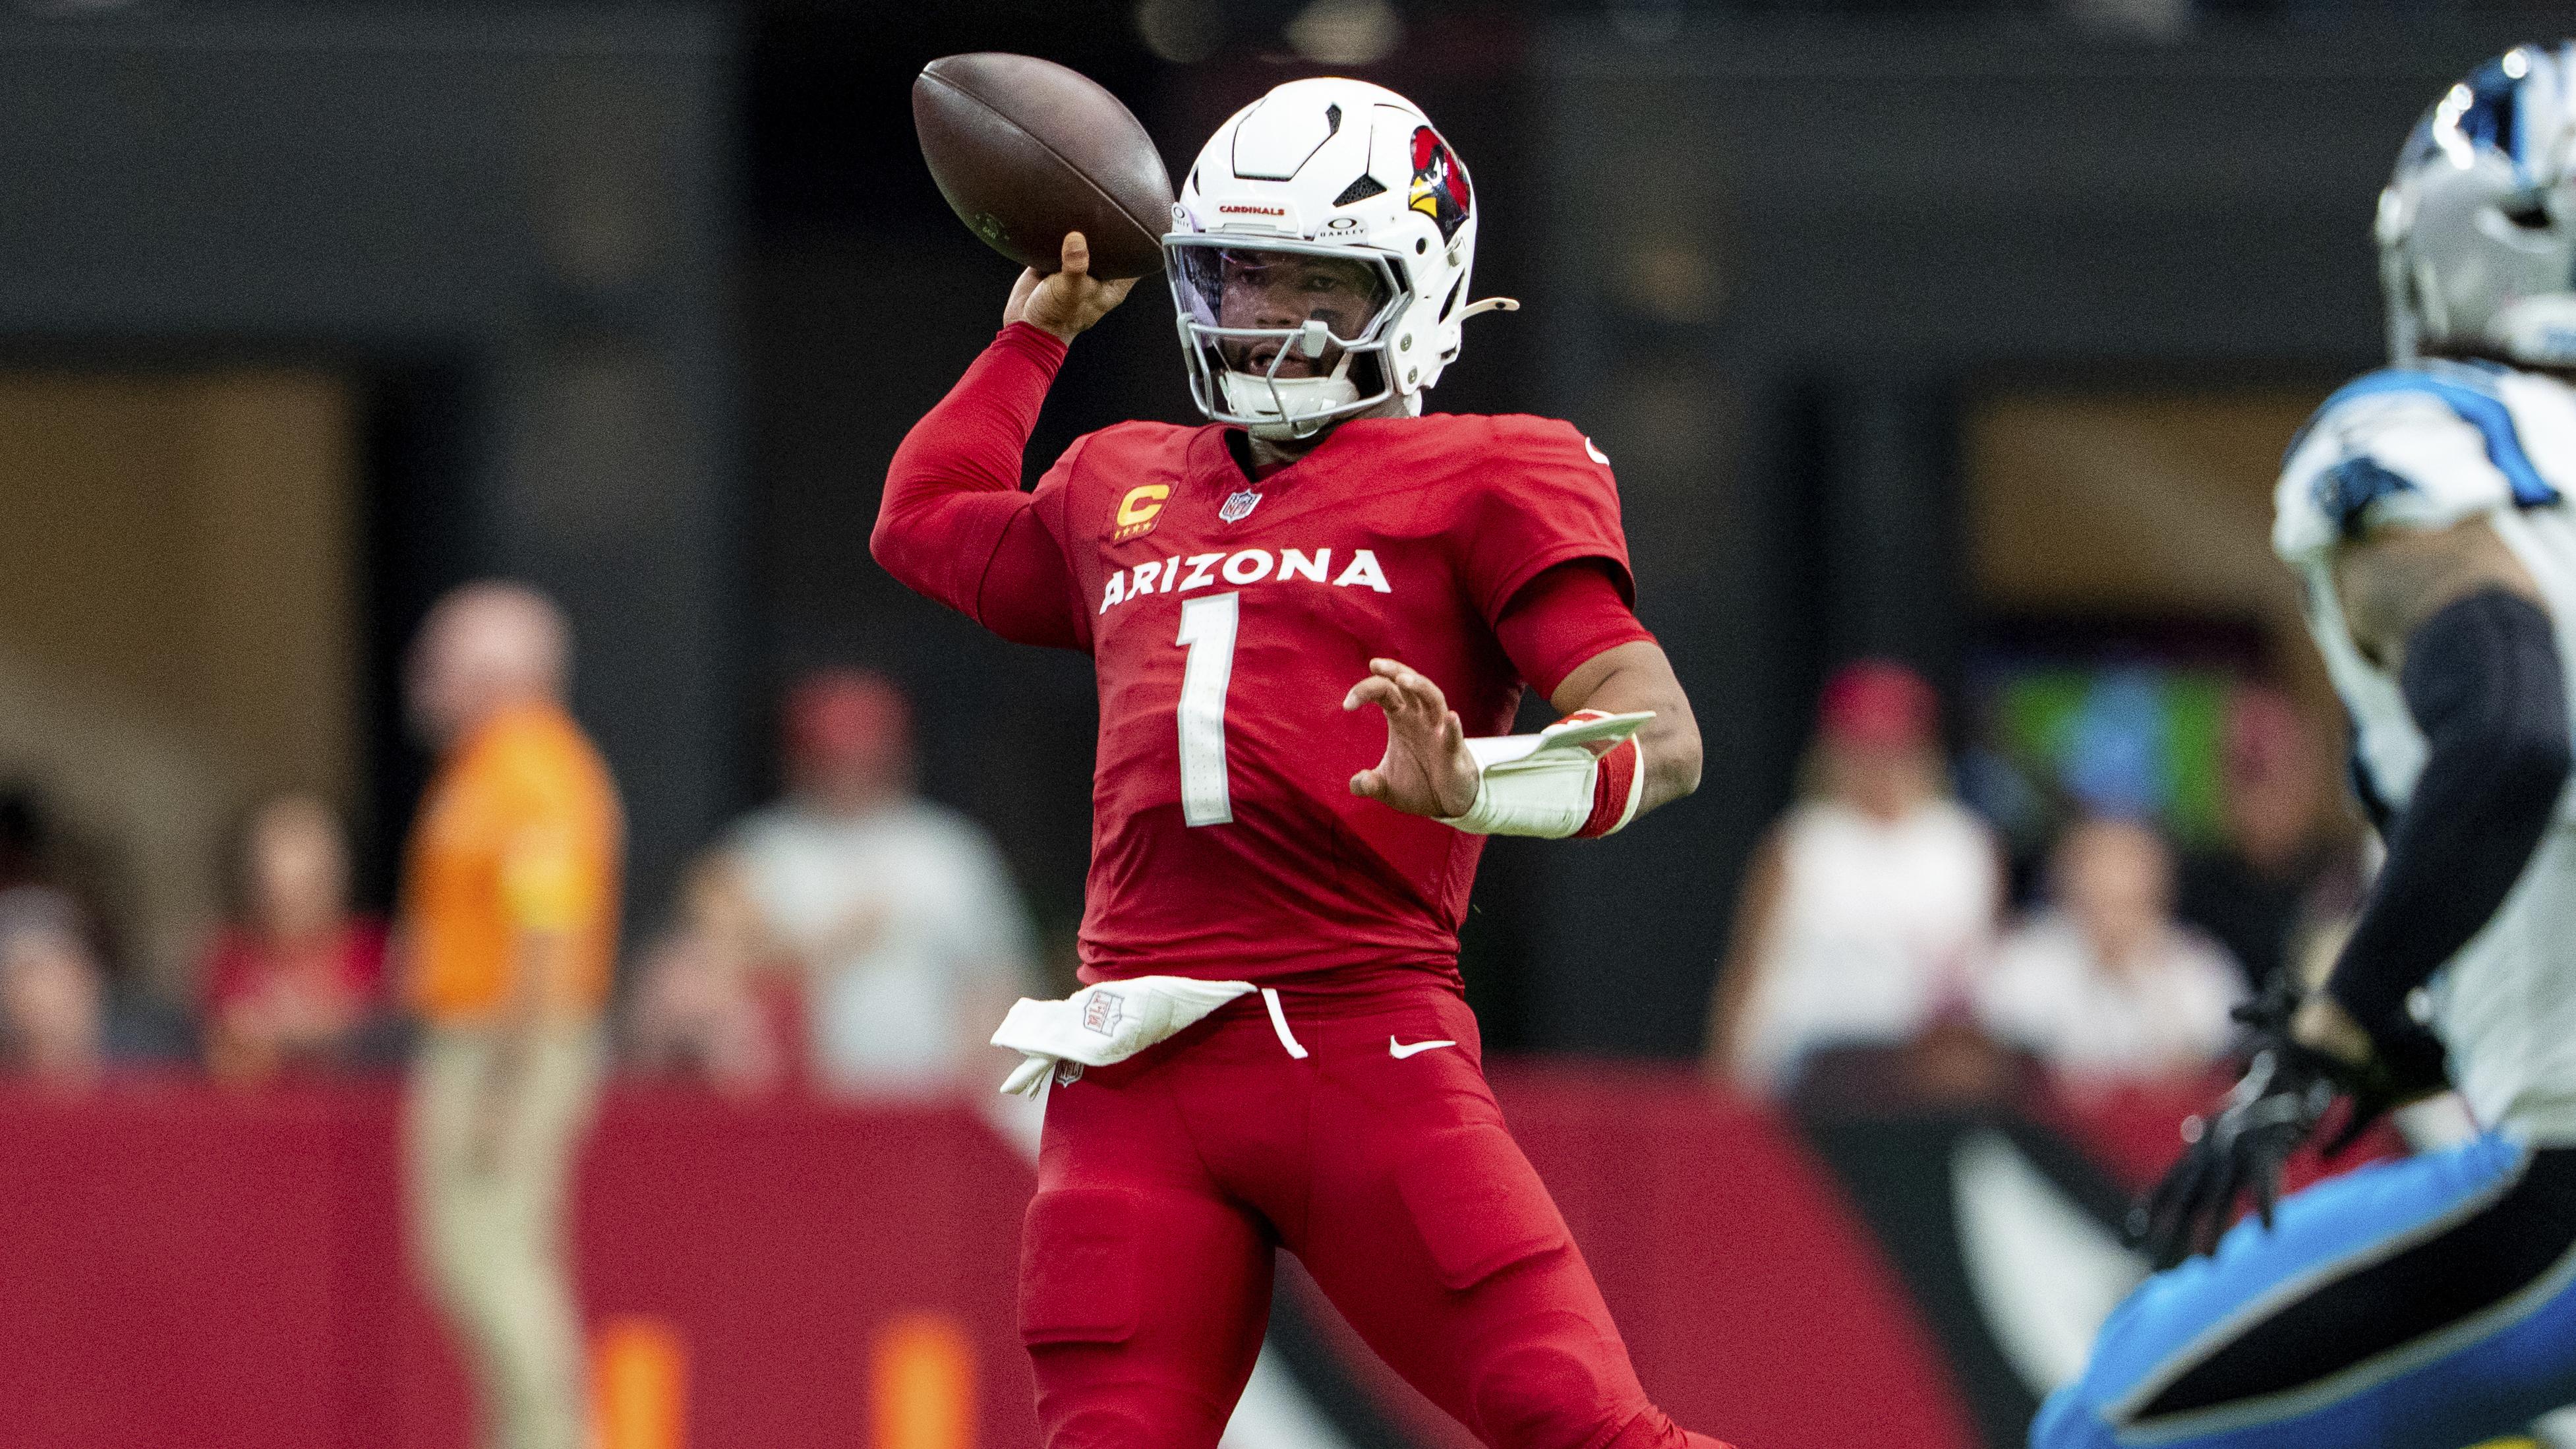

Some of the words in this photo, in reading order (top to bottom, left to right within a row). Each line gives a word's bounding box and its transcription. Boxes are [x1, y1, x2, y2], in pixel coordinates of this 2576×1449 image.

[1219, 206, 1285, 216] CARDINALS
[1117, 485, 1169, 527] C
[1099, 548, 1391, 614] ARIZONA
[1176, 591, 1239, 828] 1
